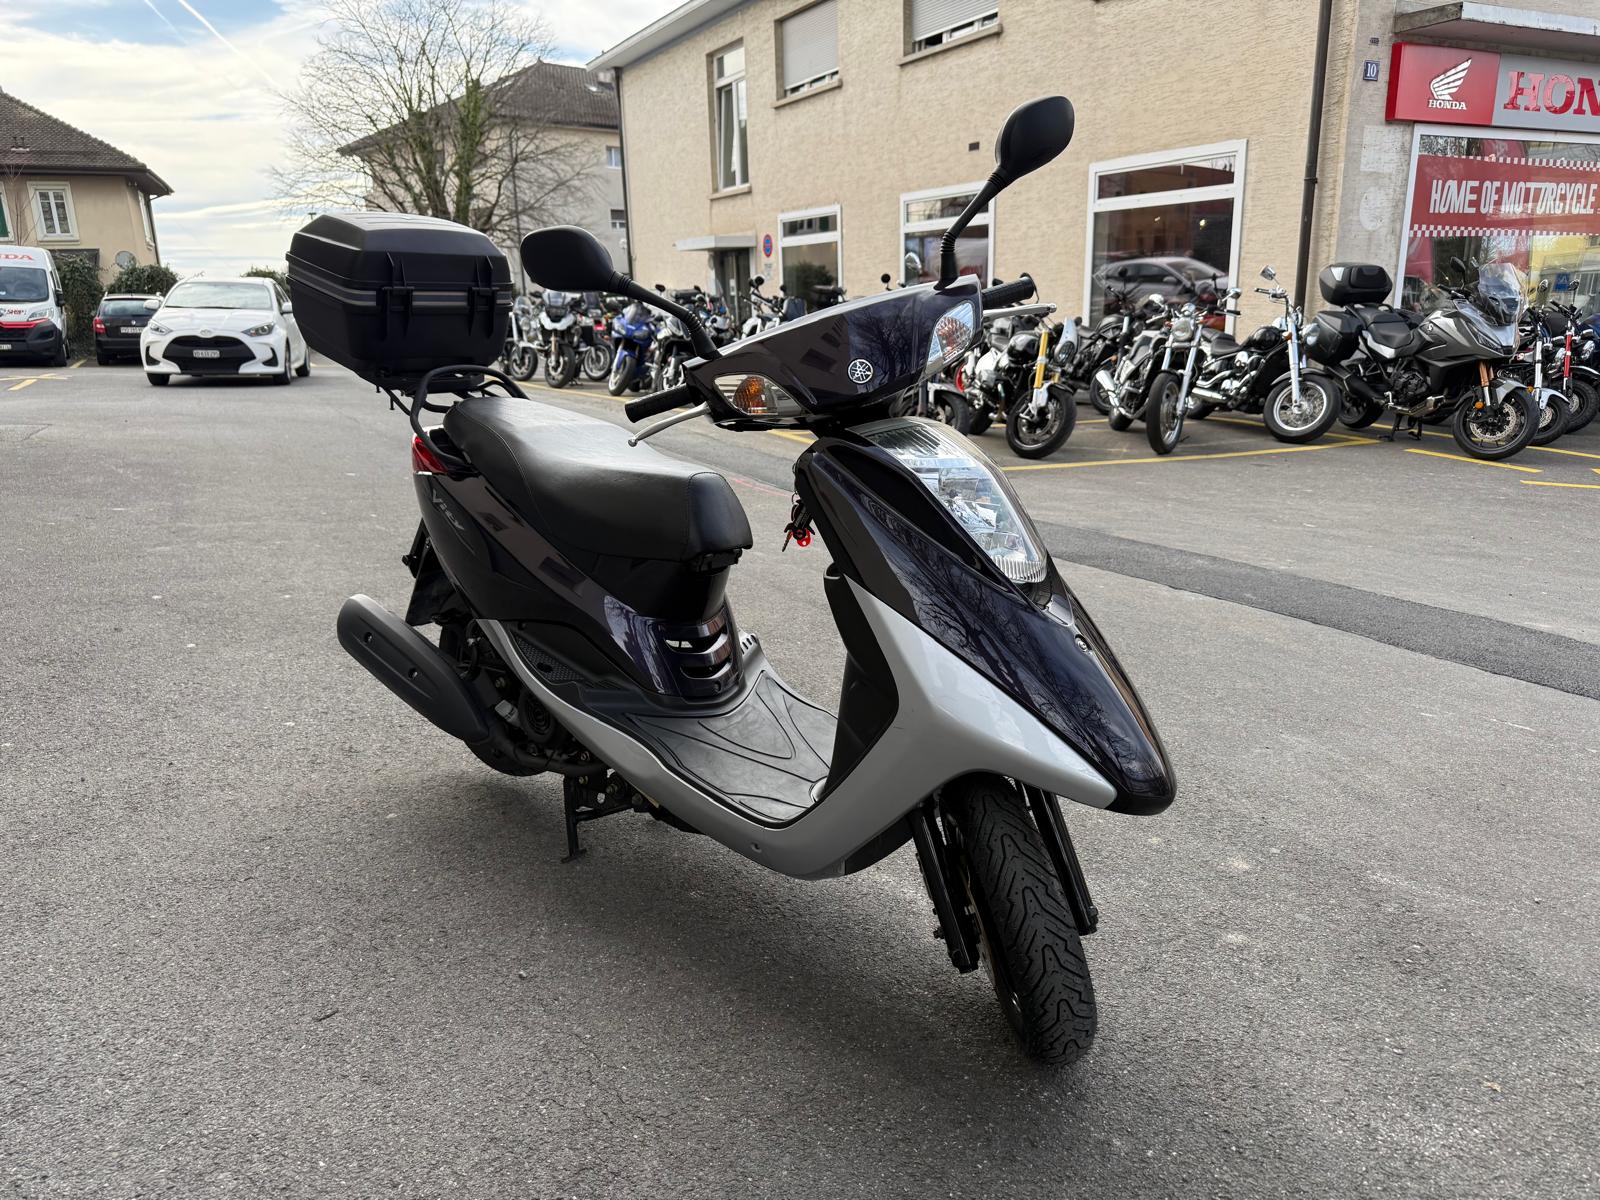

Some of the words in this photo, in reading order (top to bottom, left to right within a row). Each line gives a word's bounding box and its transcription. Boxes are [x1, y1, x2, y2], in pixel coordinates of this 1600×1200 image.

[1366, 63, 1377, 77] 10
[1428, 99, 1467, 110] HONDA
[1429, 180, 1480, 213] HOME
[1480, 181, 1501, 213] OF
